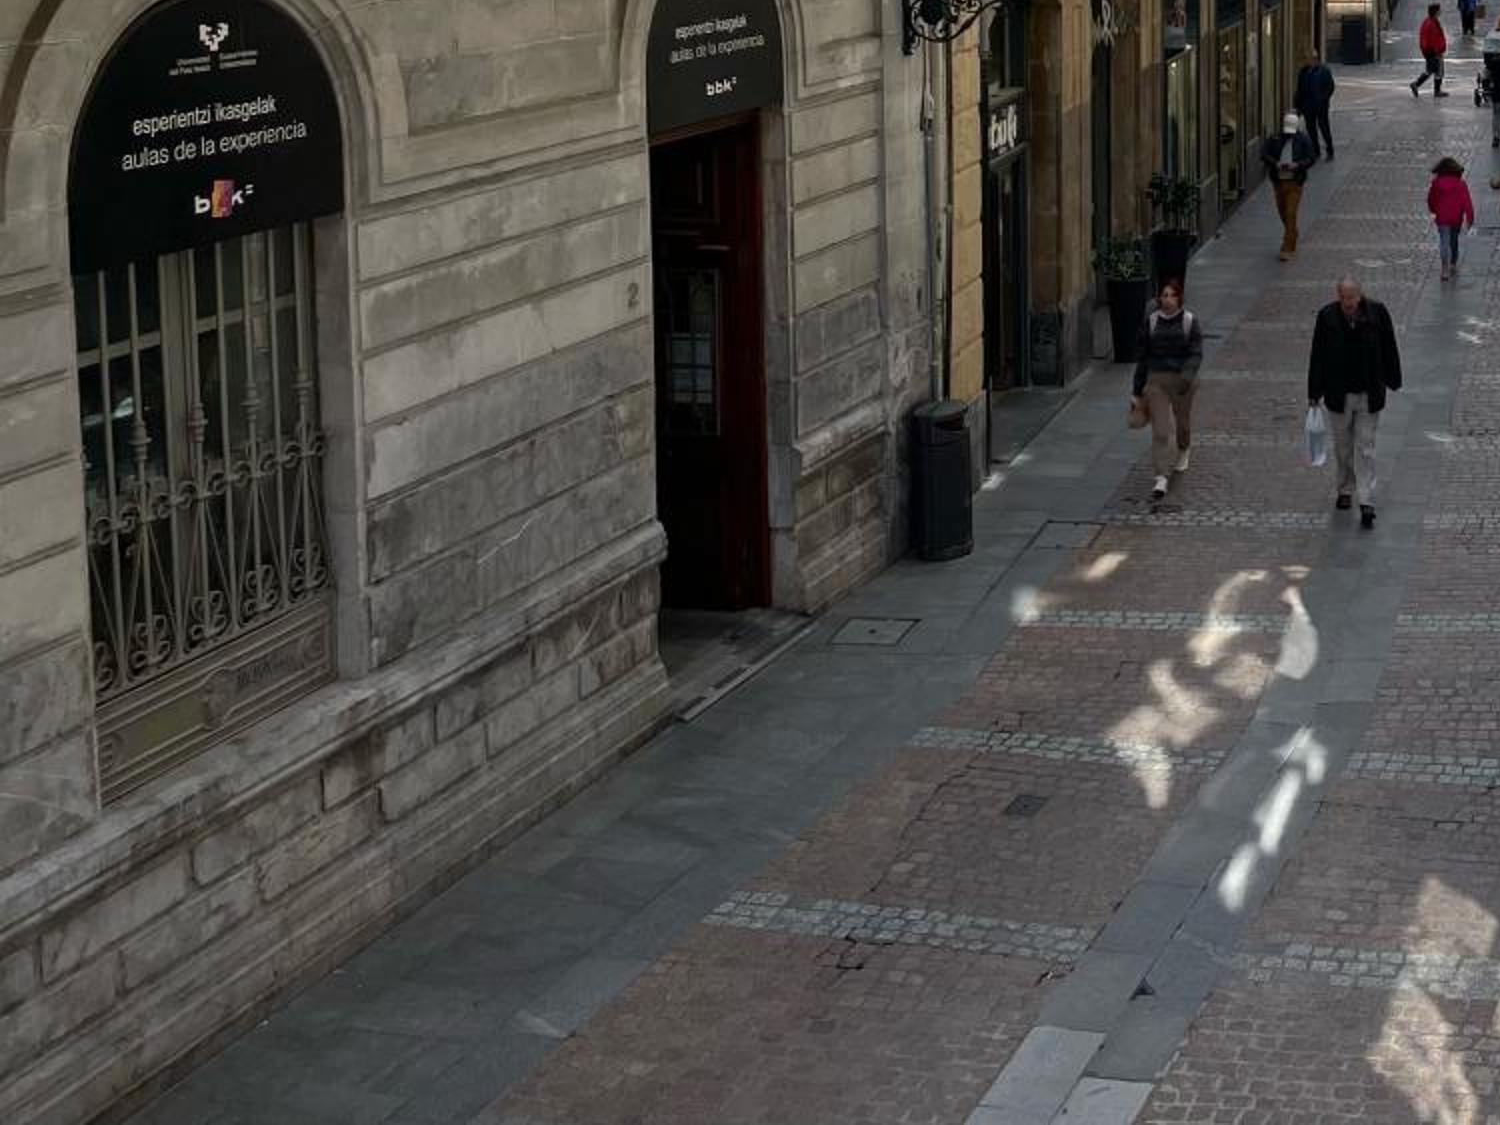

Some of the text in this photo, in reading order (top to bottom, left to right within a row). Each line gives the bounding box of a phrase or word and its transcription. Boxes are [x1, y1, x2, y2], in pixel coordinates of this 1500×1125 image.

[132, 94, 277, 138] esperientzi ikasgelak
[121, 119, 308, 171] aulas de la experiencia
[627, 282, 640, 308] 2
